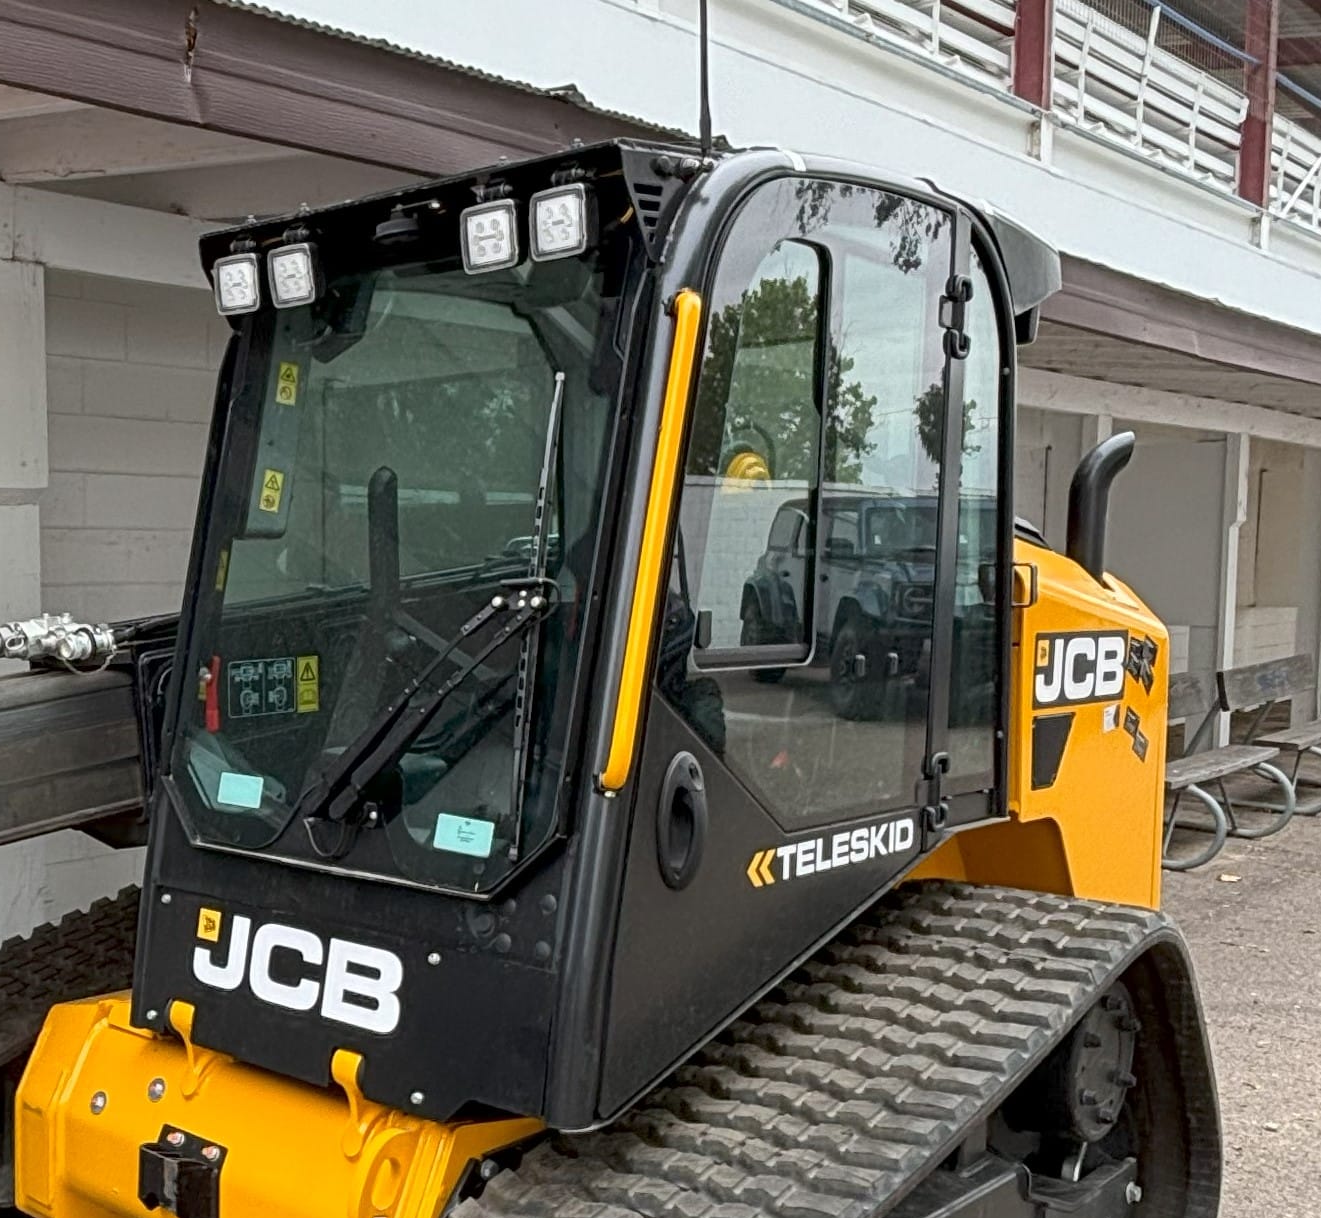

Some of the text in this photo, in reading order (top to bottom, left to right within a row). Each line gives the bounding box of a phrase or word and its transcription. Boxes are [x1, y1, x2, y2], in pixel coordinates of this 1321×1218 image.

[1035, 637, 1125, 703] JCB
[776, 818, 914, 881] TELESKID
[192, 914, 404, 1034] JCB
